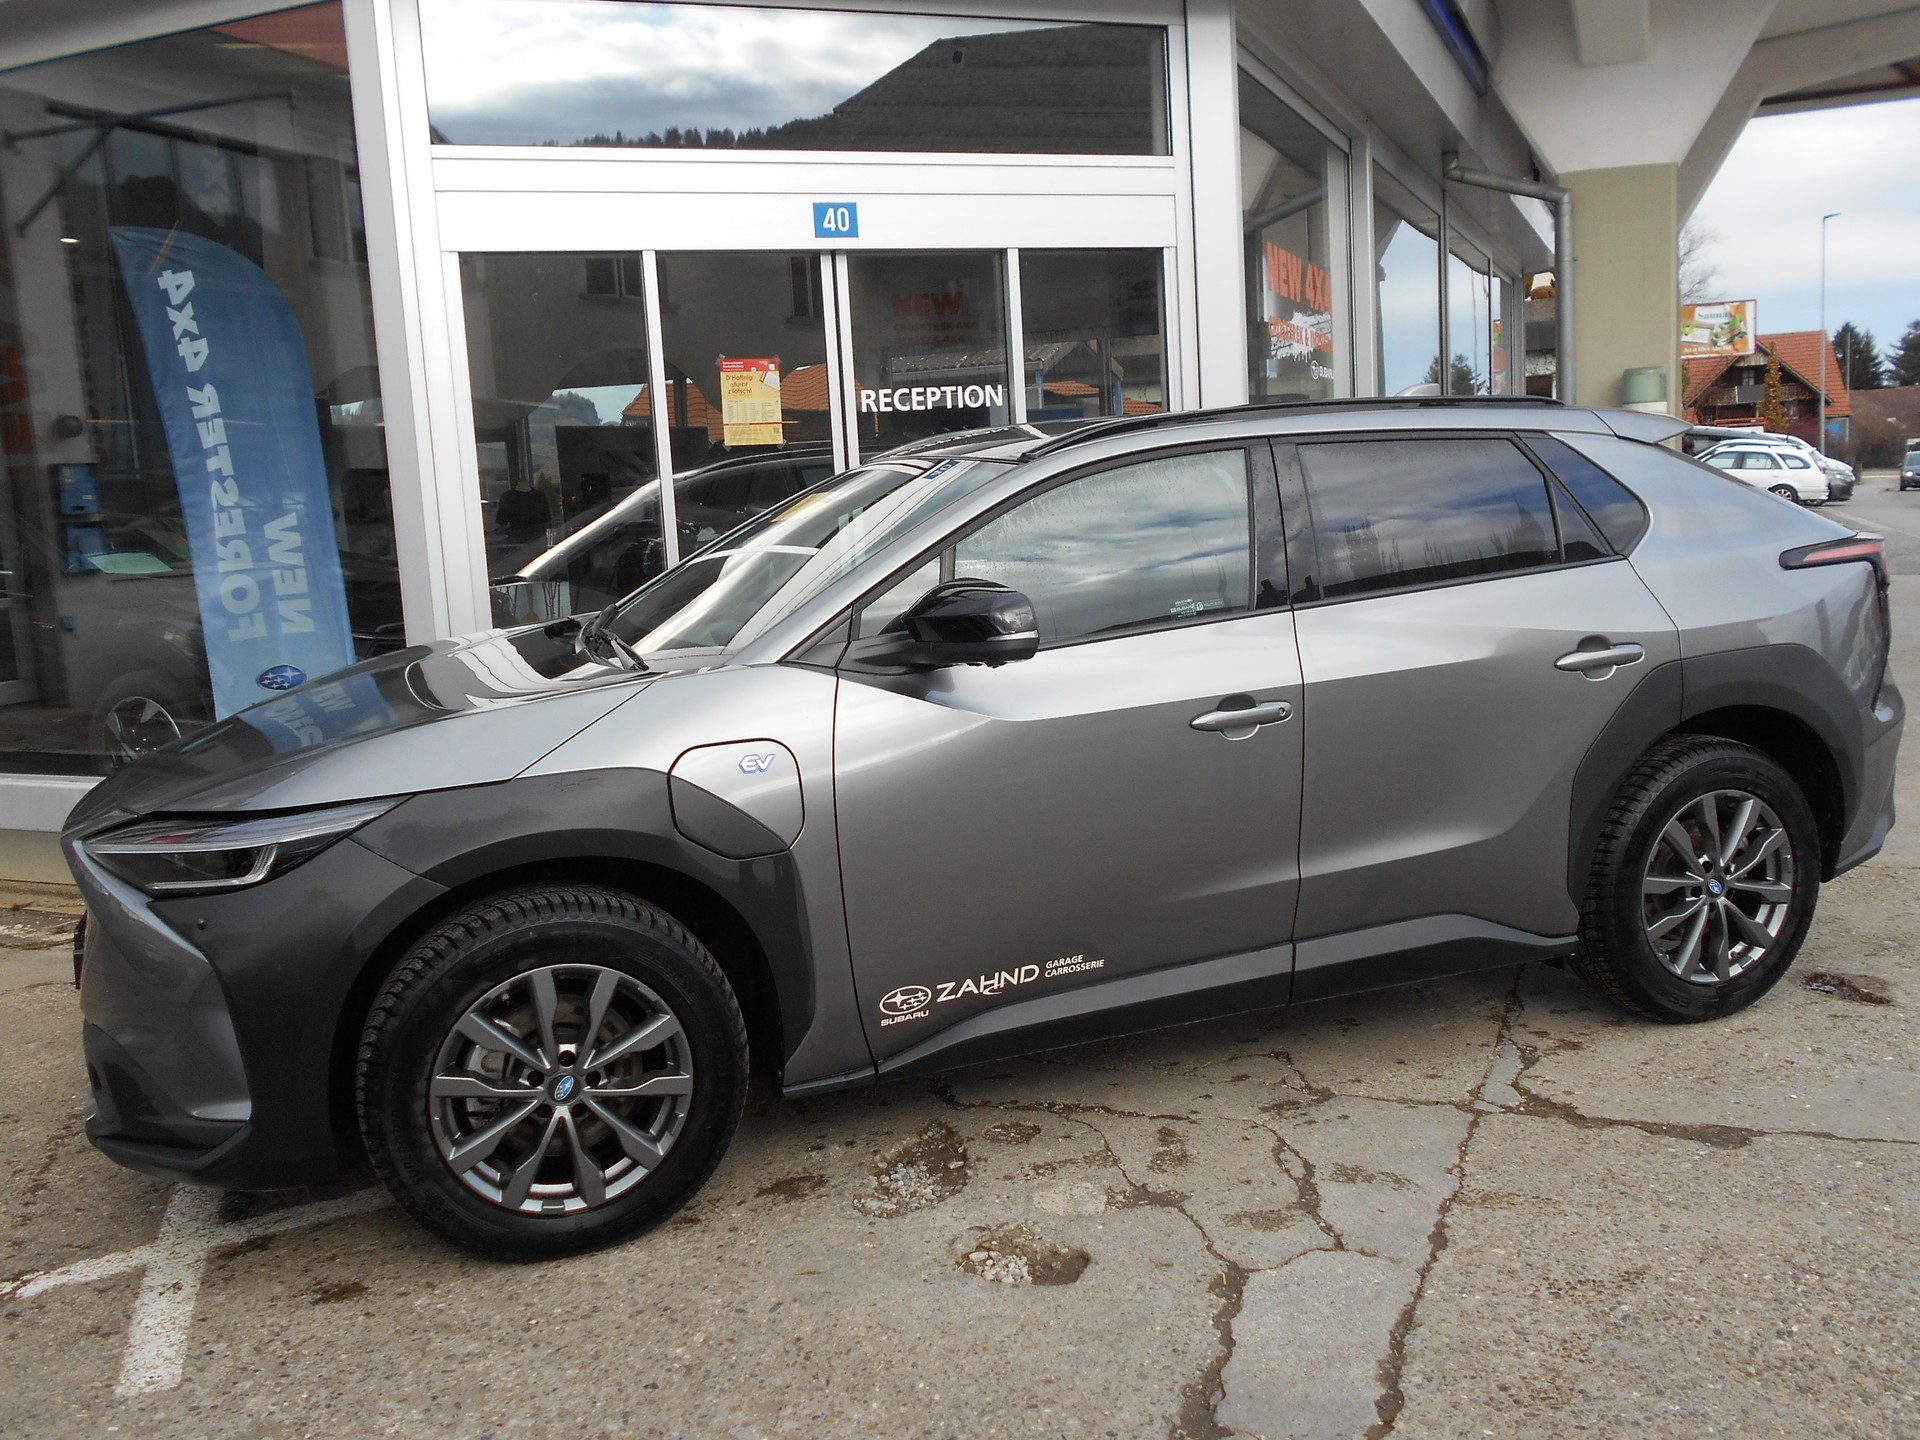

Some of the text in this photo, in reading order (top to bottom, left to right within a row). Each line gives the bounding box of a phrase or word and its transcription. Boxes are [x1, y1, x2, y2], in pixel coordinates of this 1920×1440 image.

[823, 207, 850, 232] 40
[1267, 240, 1304, 303] NEW
[891, 291, 963, 316] NEW
[860, 384, 1003, 413] RECEPTION
[738, 753, 776, 774] EV
[1044, 959, 1105, 978] CARROSSERIE
[1045, 954, 1084, 969] GARAGE
[936, 964, 1040, 1003] ZAHND
[880, 1009, 930, 1027] SUBARU
